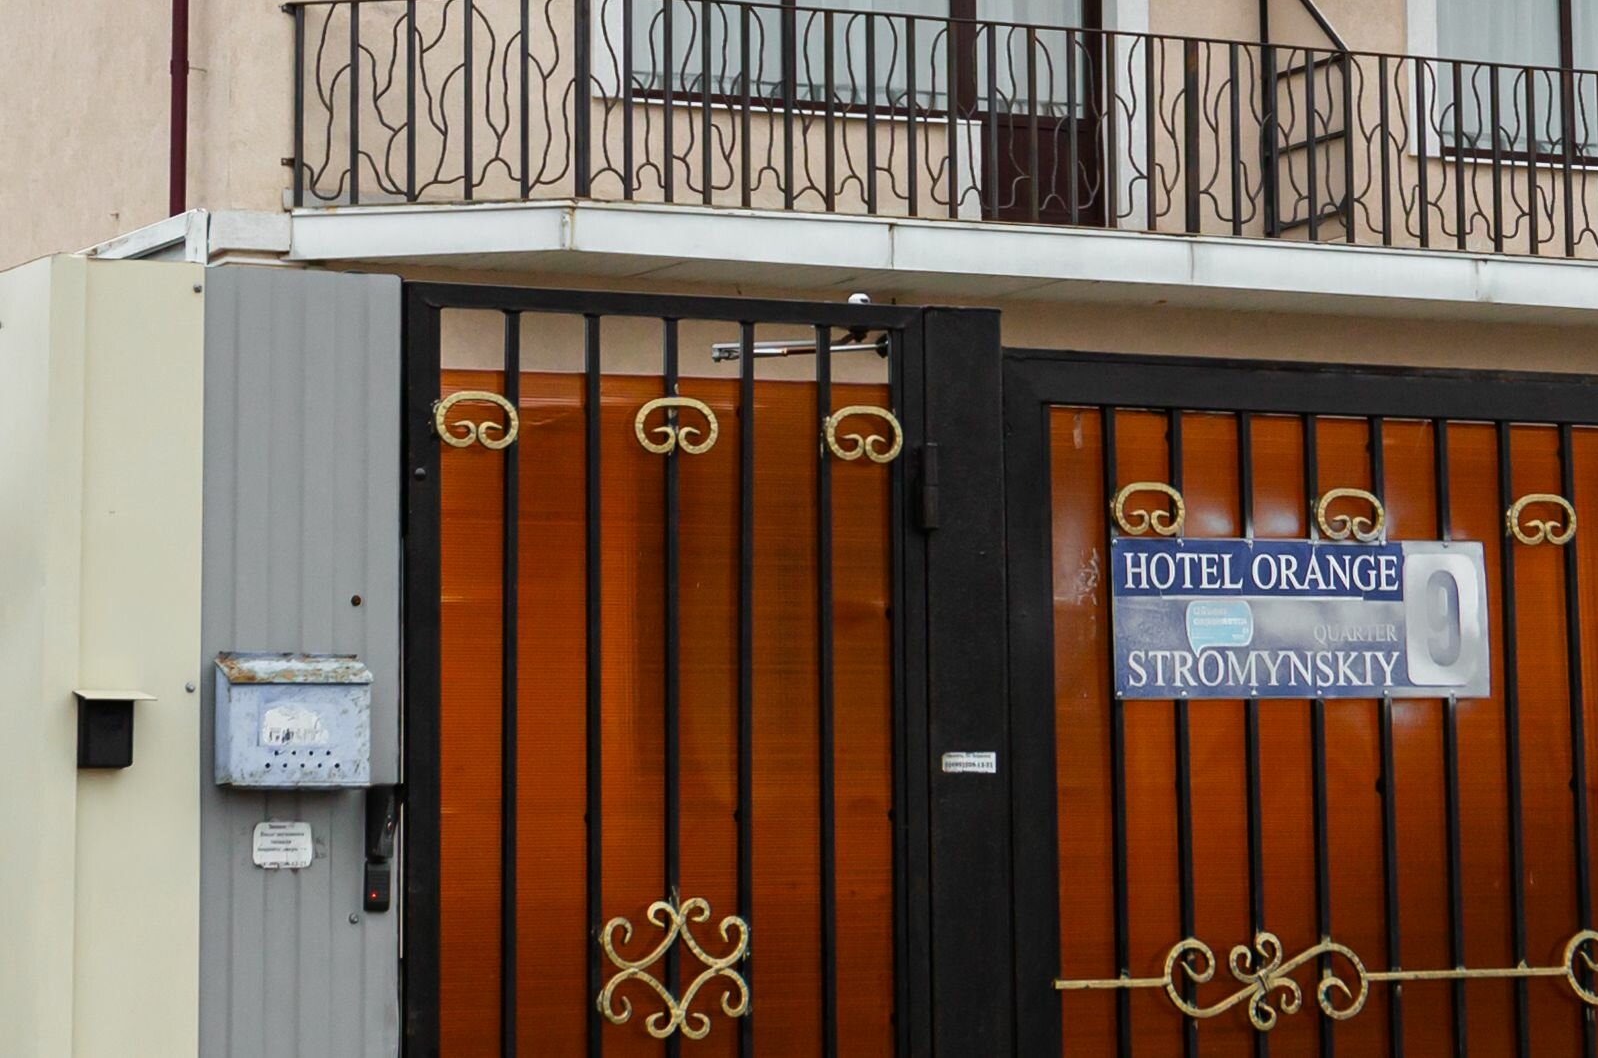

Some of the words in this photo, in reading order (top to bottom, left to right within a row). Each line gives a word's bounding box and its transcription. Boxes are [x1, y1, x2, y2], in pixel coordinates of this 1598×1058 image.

[1123, 552, 1244, 590] HOTEL
[1251, 553, 1399, 592] ORANGE
[1313, 623, 1398, 647] QUARTER
[1128, 649, 1400, 688] STROMYNSKIY
